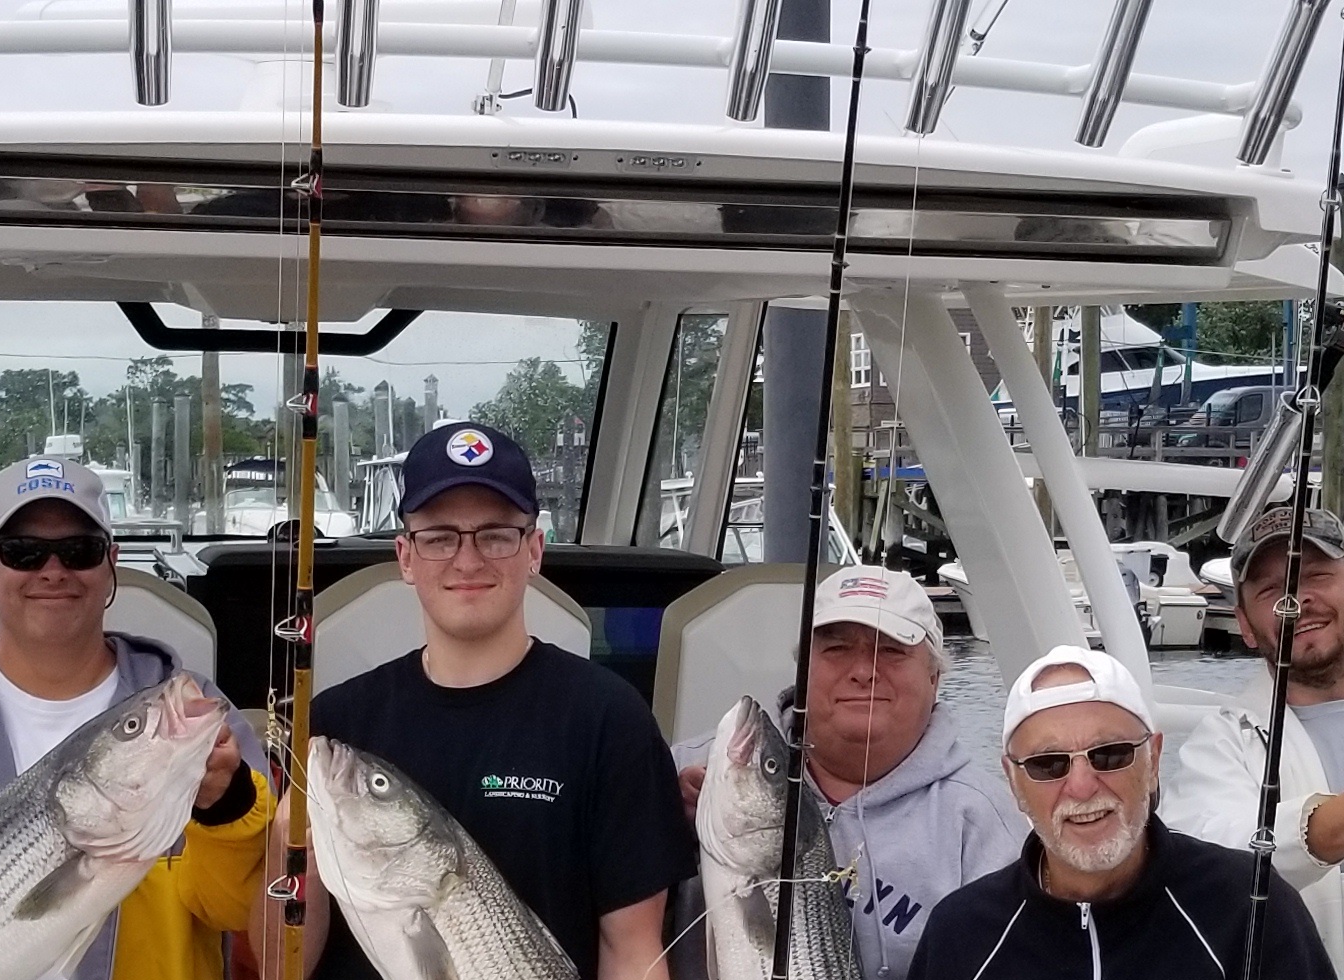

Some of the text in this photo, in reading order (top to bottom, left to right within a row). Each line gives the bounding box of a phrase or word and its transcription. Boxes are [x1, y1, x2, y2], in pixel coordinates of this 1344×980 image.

[17, 477, 75, 494] COSTA
[503, 776, 565, 796] PRIORITY
[839, 867, 923, 935] LYN
